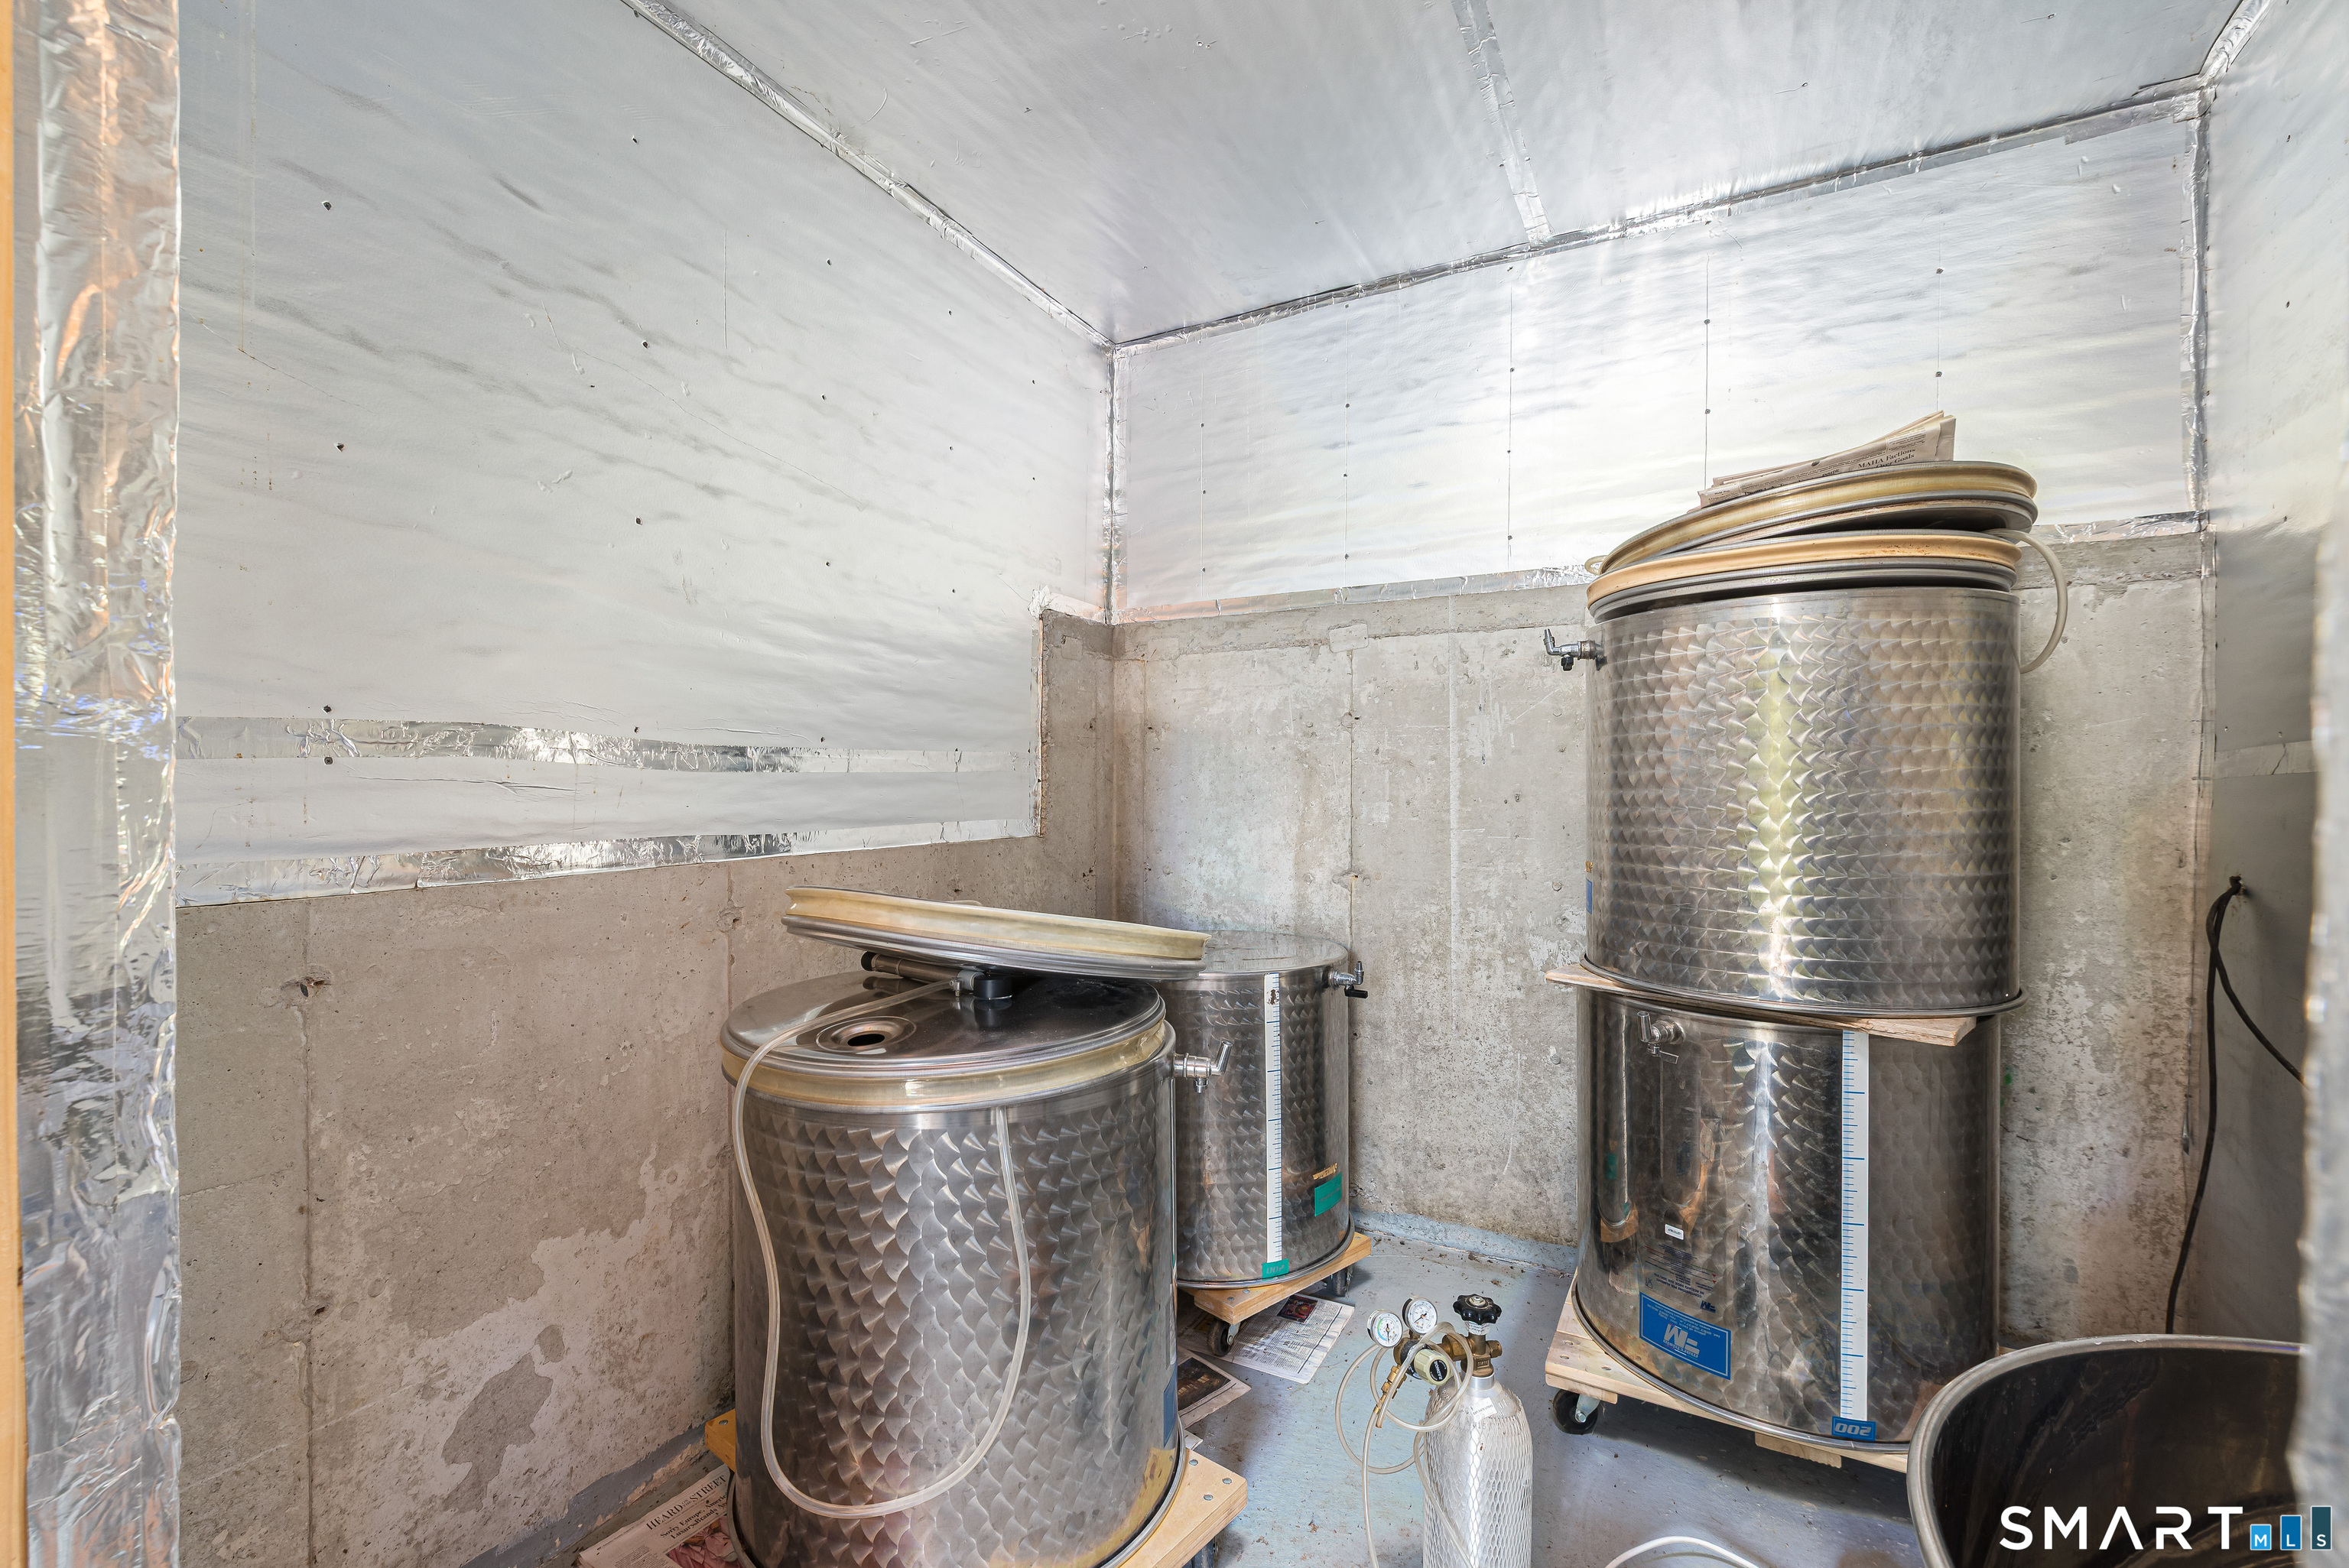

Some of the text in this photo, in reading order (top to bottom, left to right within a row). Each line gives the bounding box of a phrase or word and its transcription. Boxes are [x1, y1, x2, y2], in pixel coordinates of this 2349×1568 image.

[1858, 449, 1915, 469] MAHA Factions
[1894, 454, 1915, 463] Goals
[1663, 1339, 1699, 1358] marchisio
[1834, 1423, 1872, 1437] 200
[646, 1504, 684, 1531] HEARD
[689, 1475, 726, 1501] STREET
[660, 1525, 680, 1537] Sorry
[679, 1509, 705, 1526] Europe,
[705, 1492, 727, 1509] Americ
[671, 1523, 695, 1540] Luxury
[694, 1508, 718, 1525] Brands
